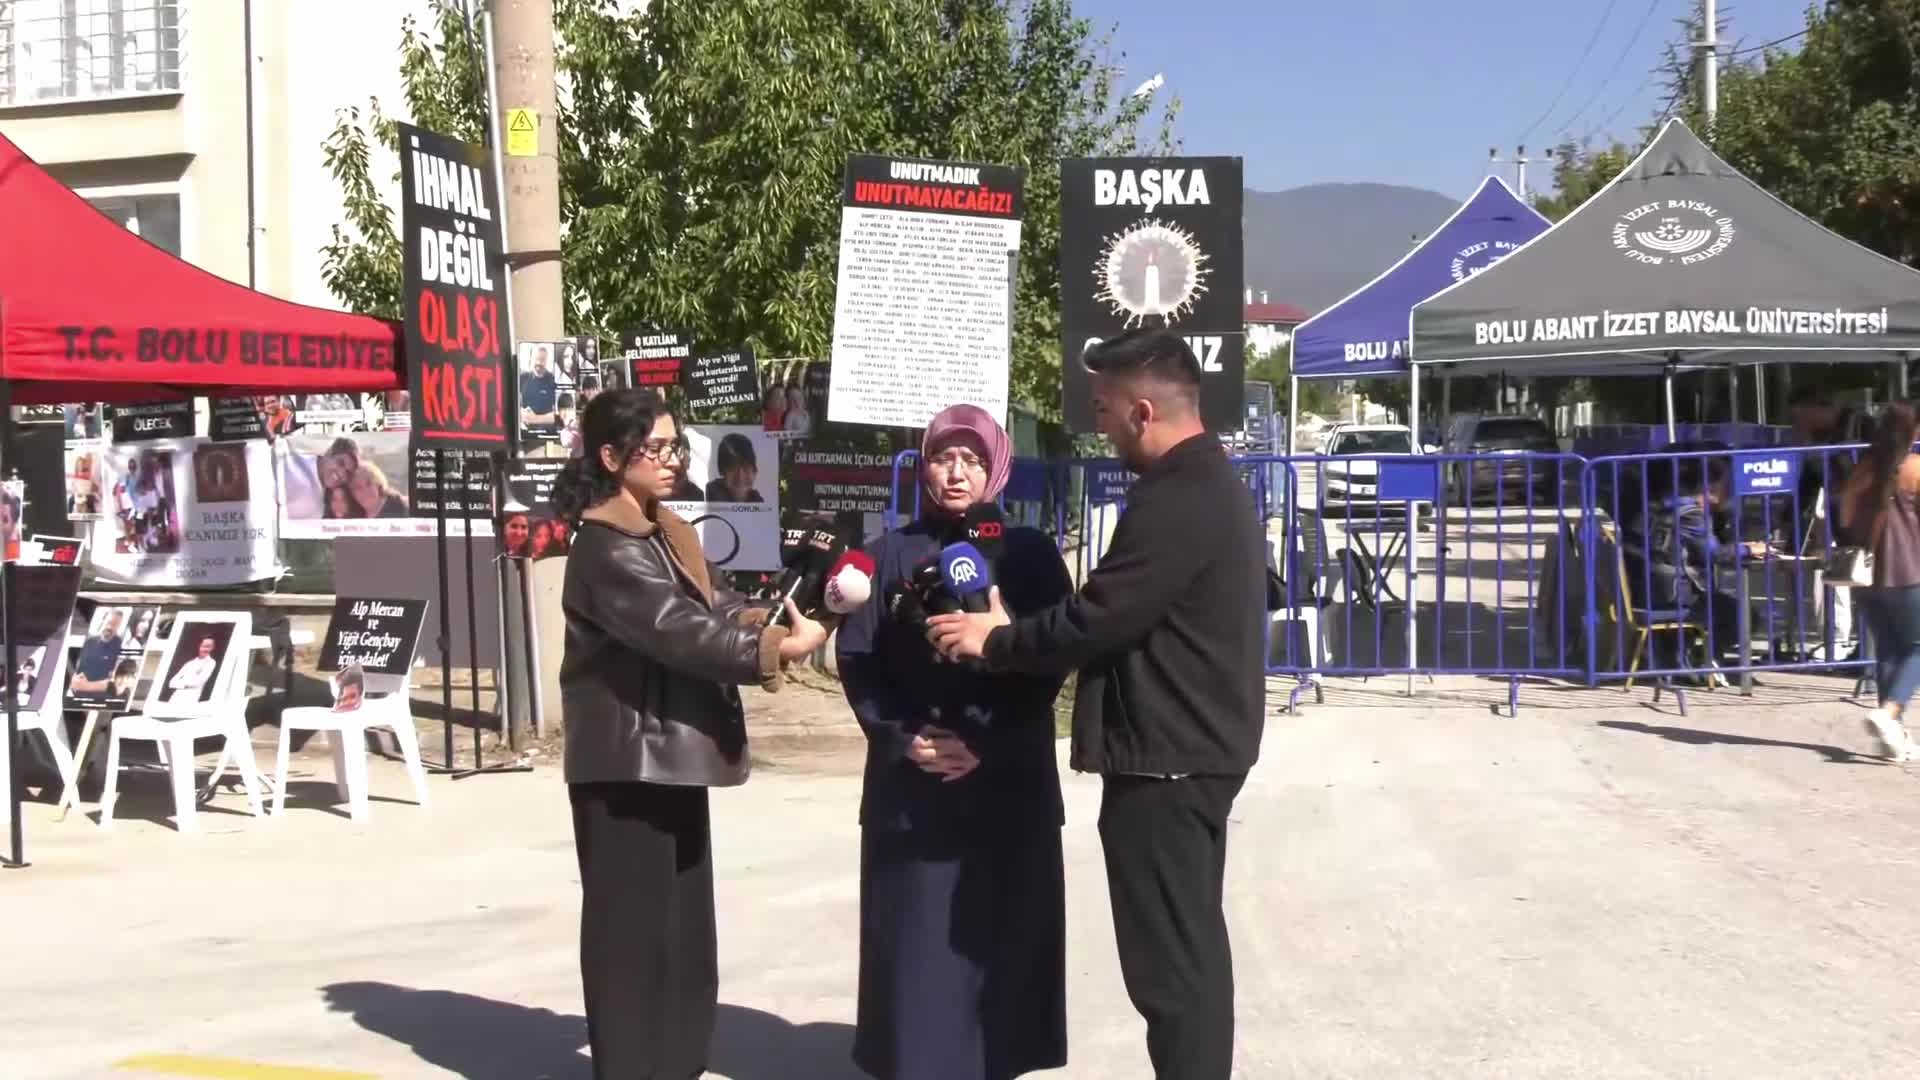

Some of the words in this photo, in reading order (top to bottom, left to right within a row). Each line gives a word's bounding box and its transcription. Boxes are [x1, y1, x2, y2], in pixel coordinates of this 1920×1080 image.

[411, 135, 491, 220] İHMAL
[890, 161, 981, 185] UNUTMADIK
[855, 181, 1013, 213] UNUTMAYACAĞIZ!
[1094, 168, 1211, 213] BAŞKA
[1667, 199, 1718, 217] BAYSAL
[1612, 222, 1631, 249] ABANT
[420, 218, 493, 291] DEĞİL
[1624, 249, 1663, 265] BOLU
[419, 288, 500, 360] OLASI
[1474, 321, 1527, 344] BOLU
[1532, 316, 1598, 341] ABANT
[1603, 309, 1660, 337] İZZET
[1665, 310, 1740, 334] BAYSAL
[1746, 306, 1888, 335] ÜNİVERSİTESİ
[57, 326, 123, 361] T.C.
[137, 328, 229, 364] BOLU
[1344, 342, 1387, 361] BOLU
[692, 370, 704, 378] can
[703, 377, 715, 385] can
[690, 396, 717, 408] HESAP
[719, 393, 754, 404] ZAMANI
[349, 601, 369, 620] Alp
[368, 601, 404, 617] Mercan
[367, 619, 379, 630] ve
[360, 631, 401, 652] Gençbay
